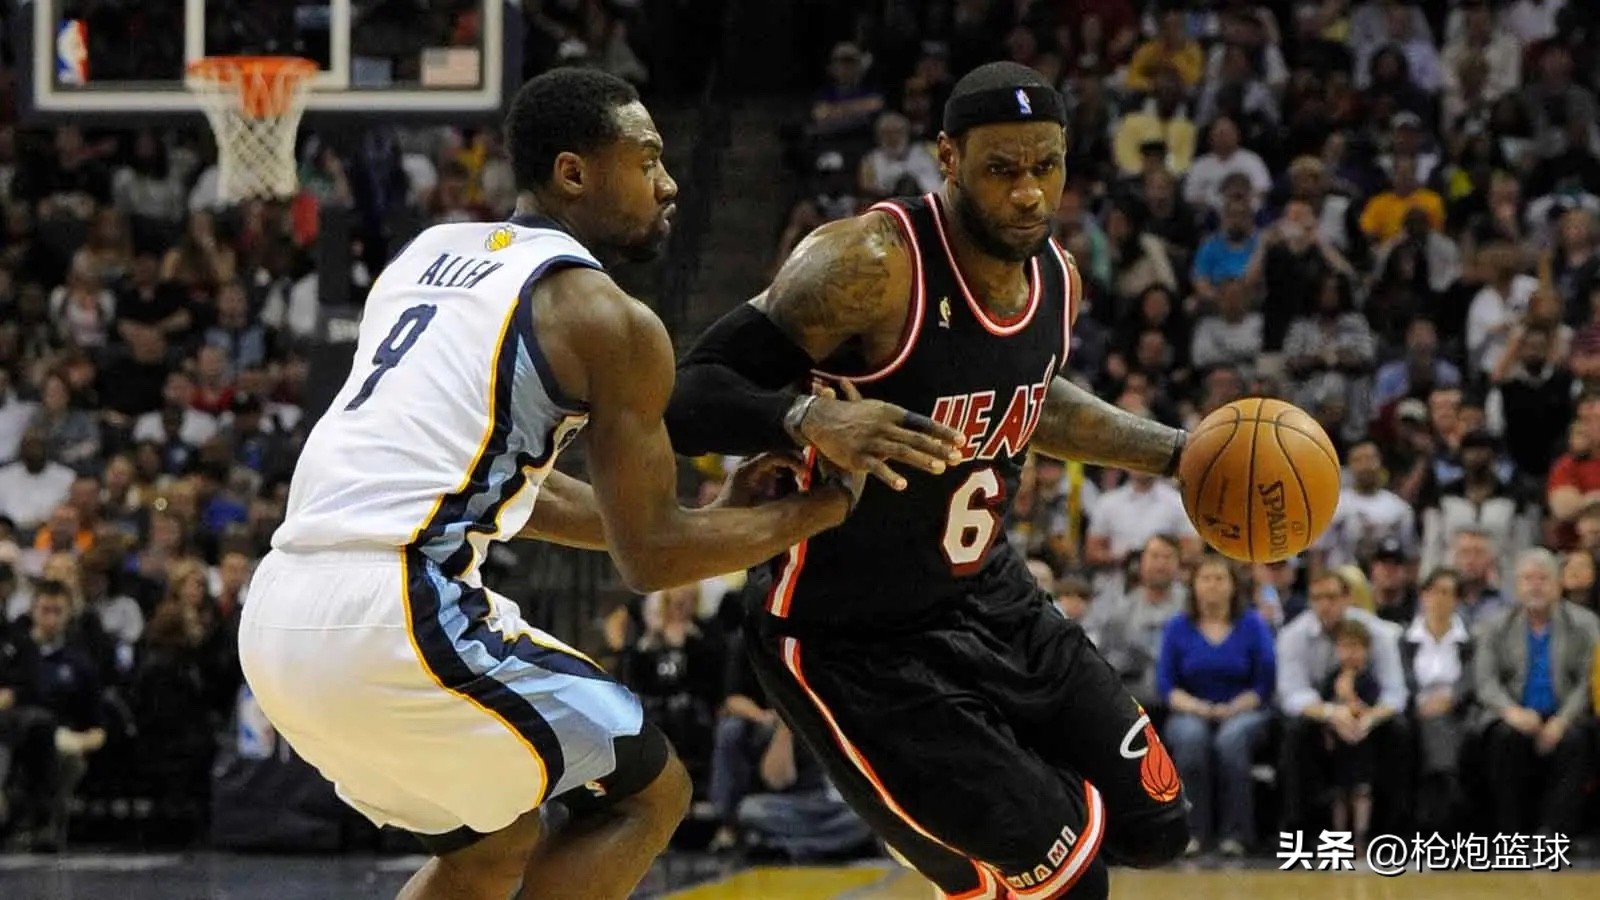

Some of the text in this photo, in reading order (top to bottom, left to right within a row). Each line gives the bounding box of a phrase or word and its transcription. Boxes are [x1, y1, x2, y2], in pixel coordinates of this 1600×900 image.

[344, 304, 437, 411] 9
[931, 354, 1056, 462] HEAT
[941, 465, 1005, 577] 6
[1006, 825, 1077, 888] MIAMI
